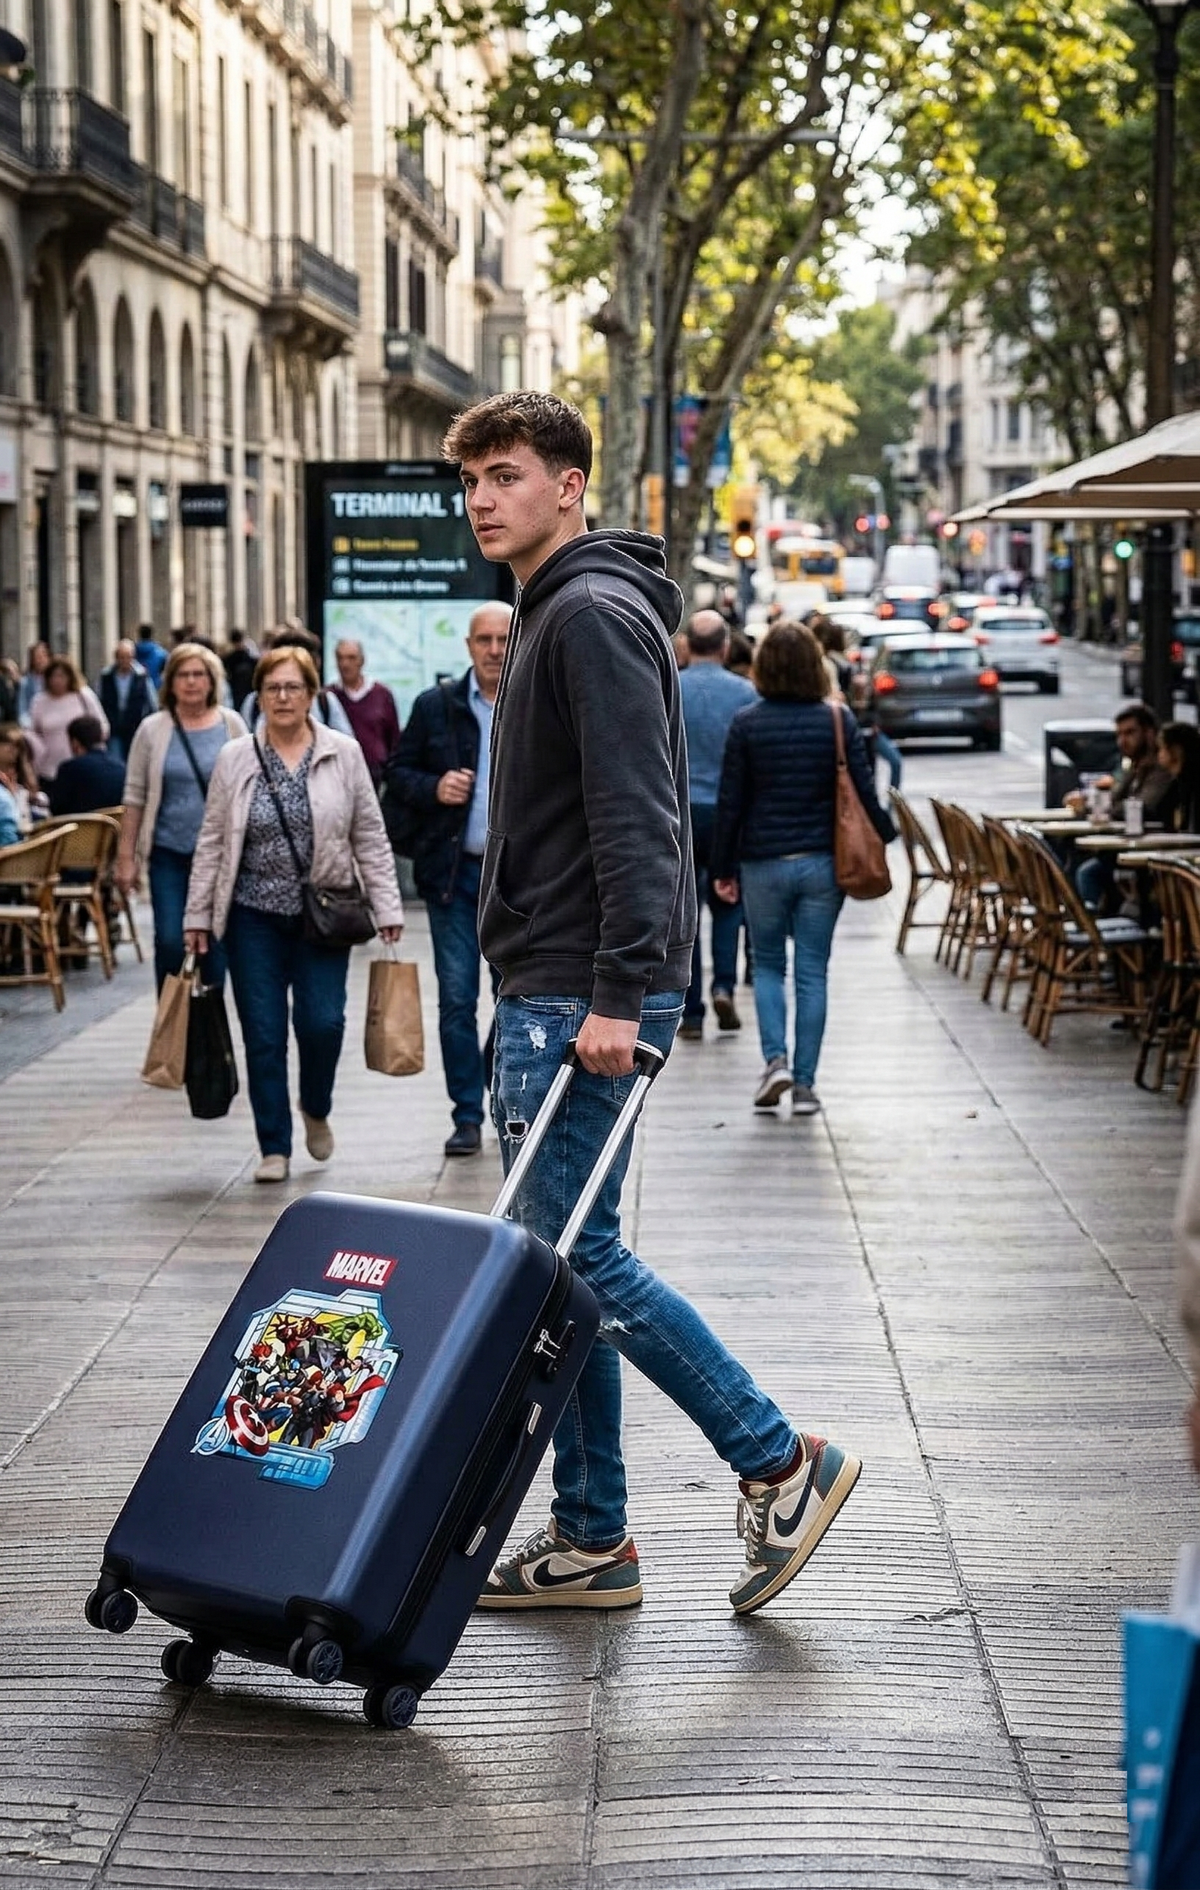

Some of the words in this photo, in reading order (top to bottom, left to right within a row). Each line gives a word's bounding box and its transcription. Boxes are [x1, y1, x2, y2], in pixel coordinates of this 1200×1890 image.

[330, 492, 447, 517] TERMINAL
[451, 492, 464, 517] 1
[325, 1251, 392, 1286] MARVEL
